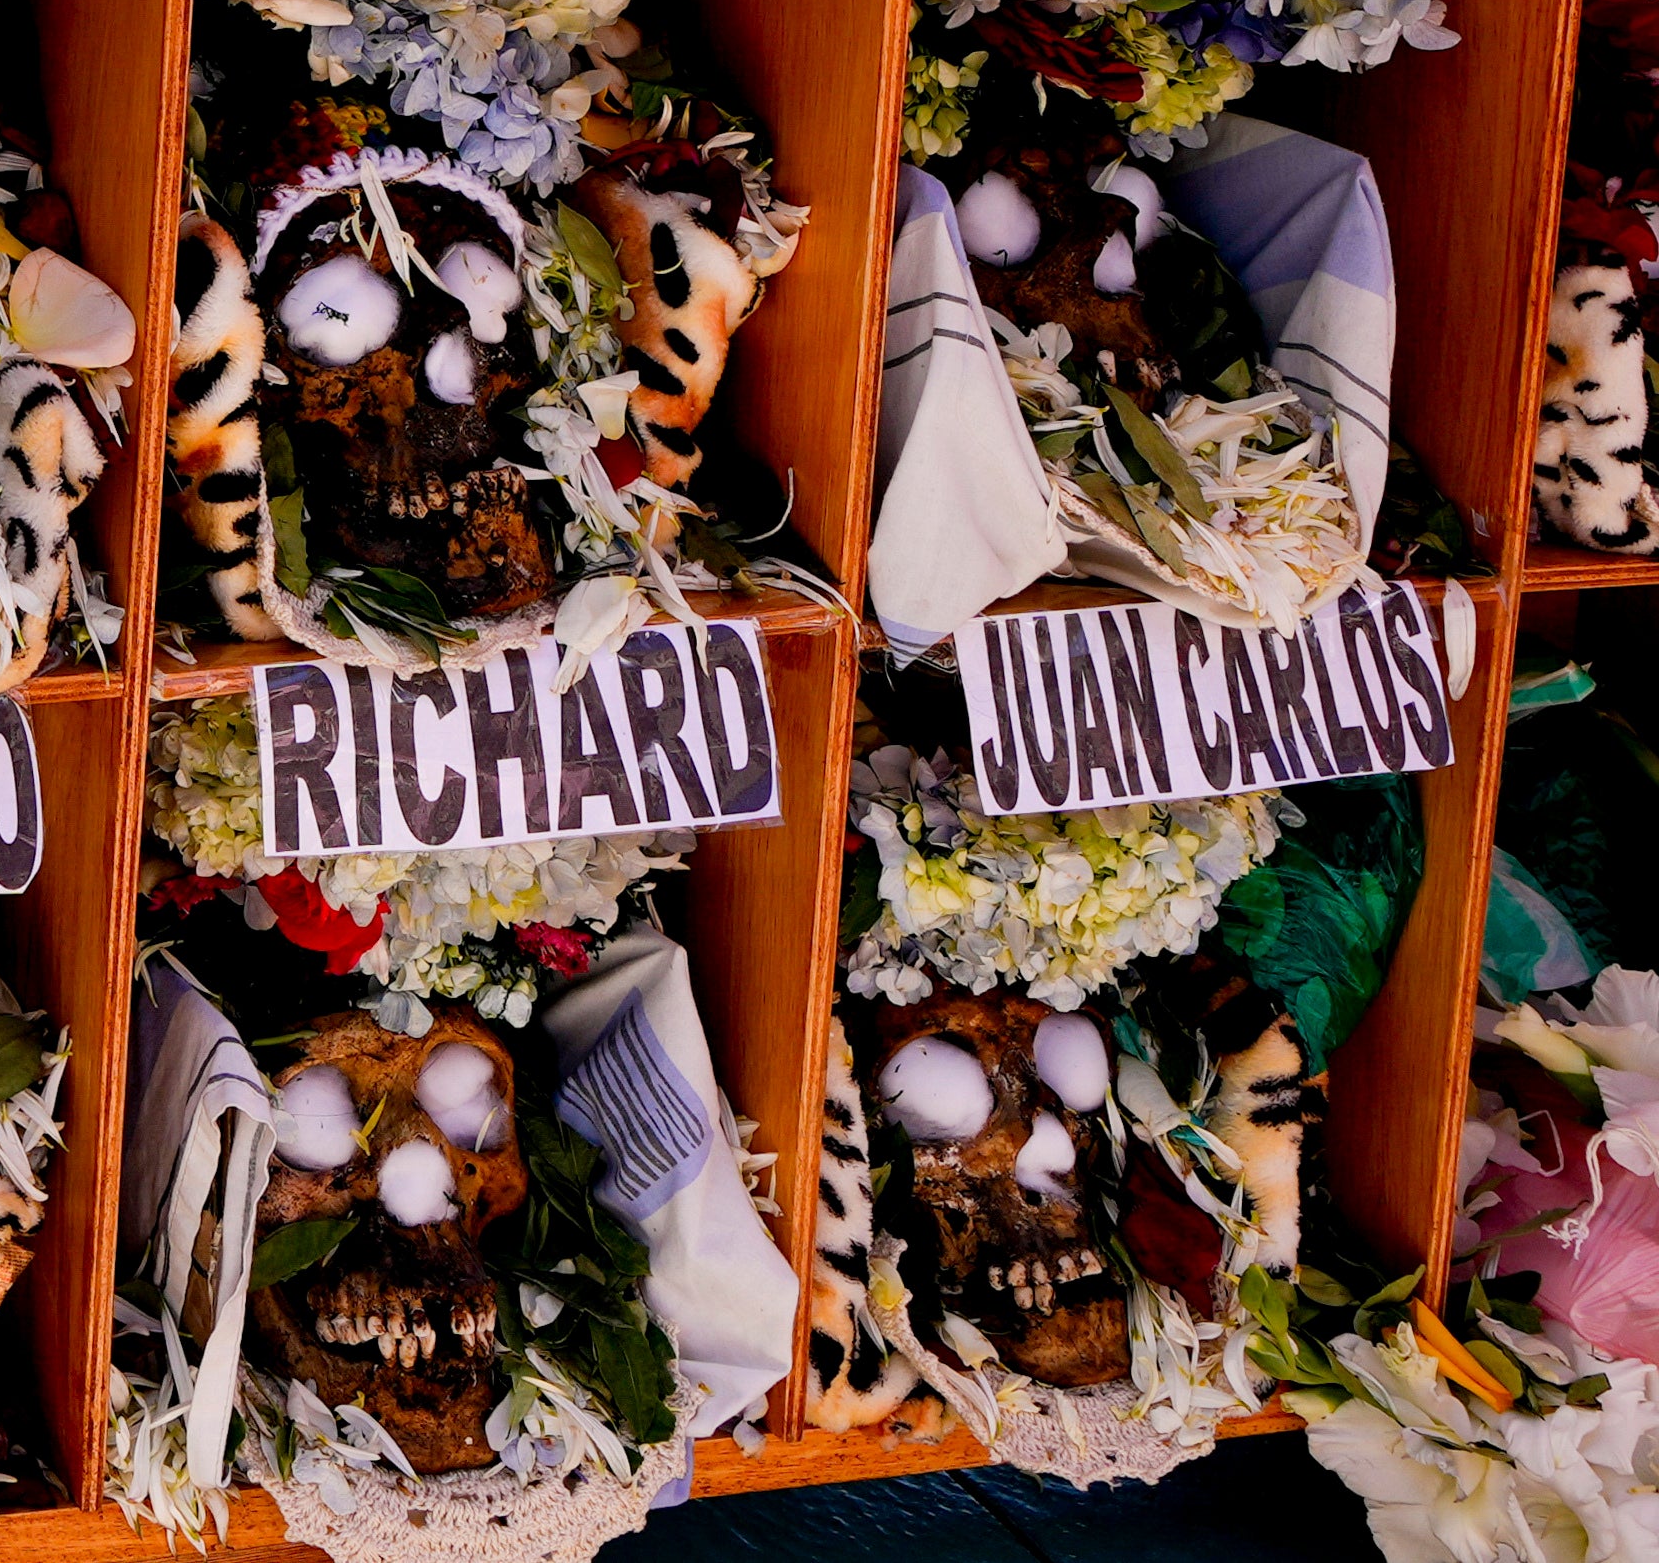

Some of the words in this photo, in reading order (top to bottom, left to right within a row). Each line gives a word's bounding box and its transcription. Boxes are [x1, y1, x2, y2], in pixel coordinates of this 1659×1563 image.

[263, 625, 777, 853] RICHARD
[980, 609, 1166, 810] JUAN
[1174, 586, 1452, 792] CARLOS
